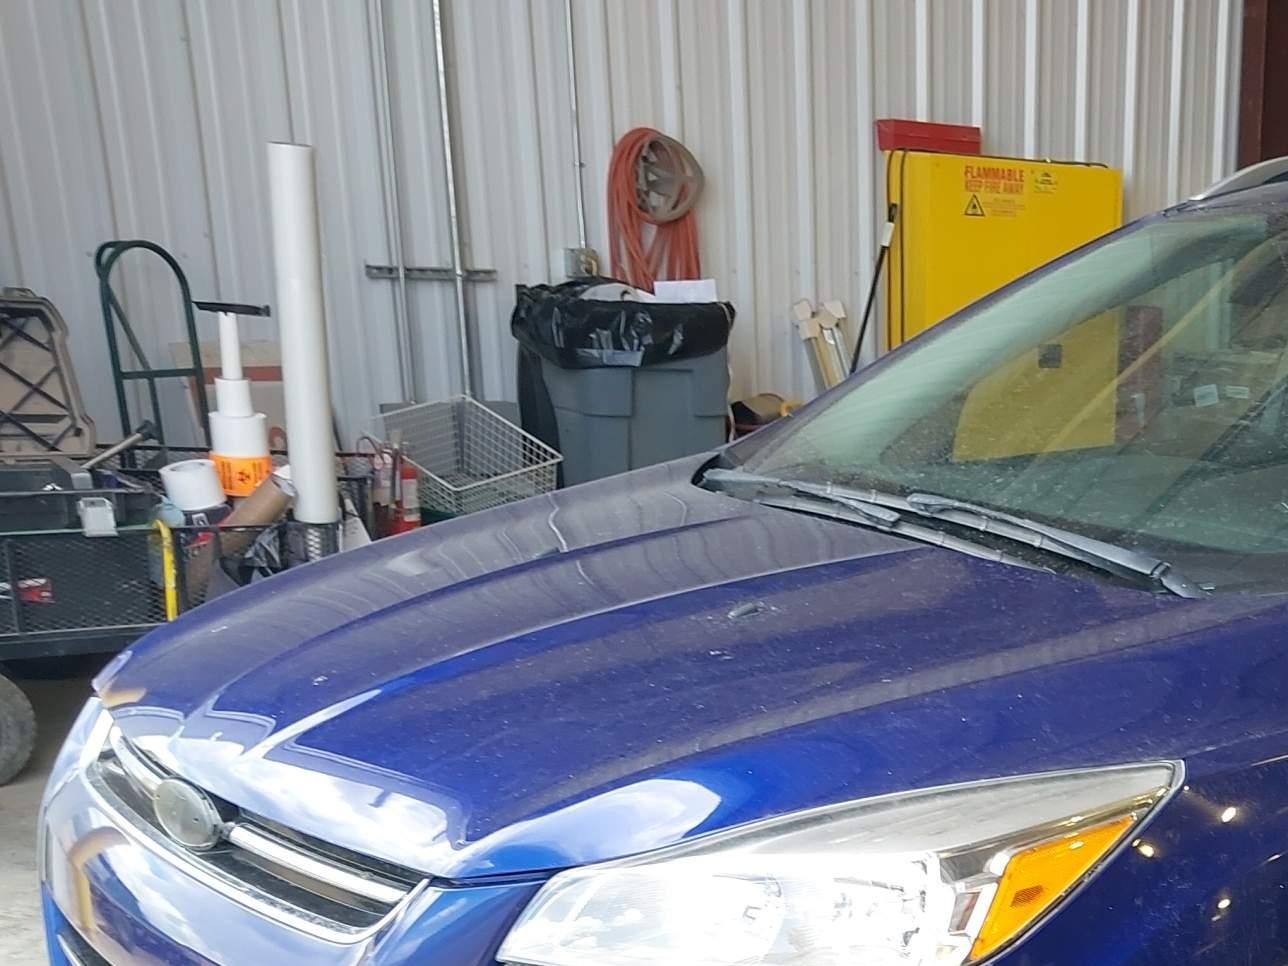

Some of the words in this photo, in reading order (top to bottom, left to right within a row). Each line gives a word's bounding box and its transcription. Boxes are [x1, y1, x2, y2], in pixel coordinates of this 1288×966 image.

[964, 165, 1025, 183] FLAMMABLE
[964, 180, 983, 193] KEEP
[984, 181, 1001, 194] FIRE
[1002, 182, 1025, 195] AWAY
